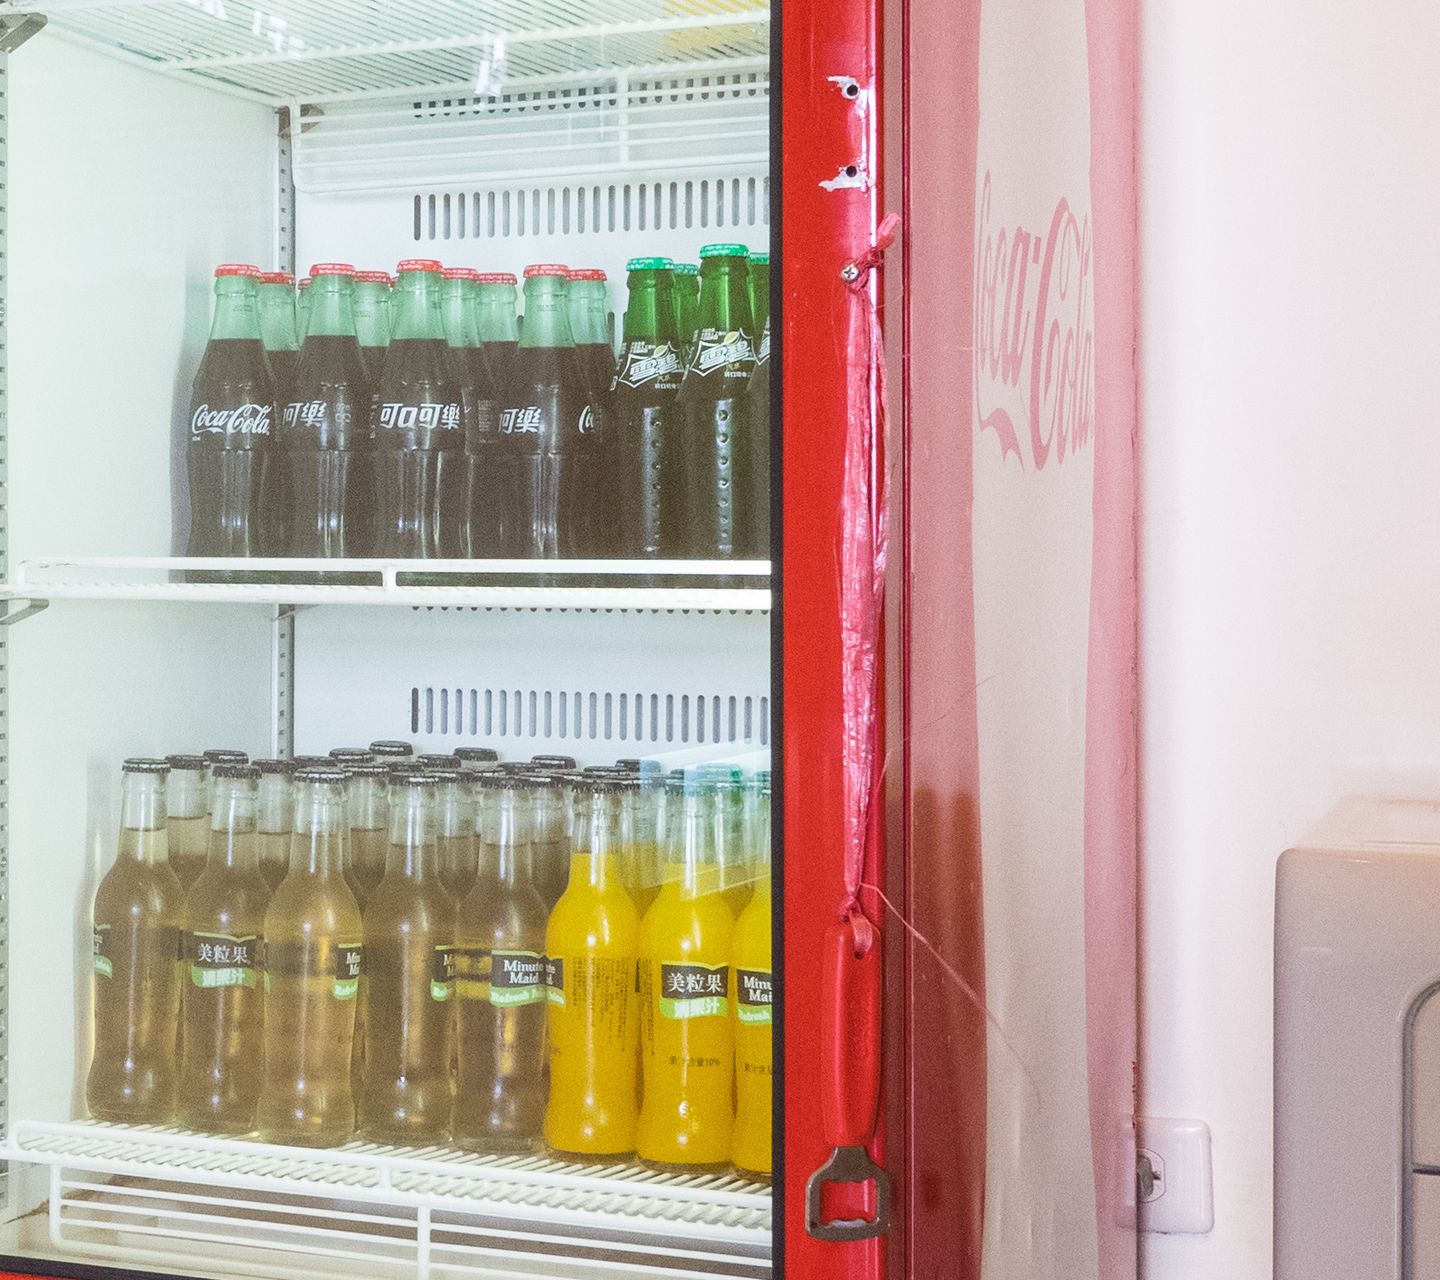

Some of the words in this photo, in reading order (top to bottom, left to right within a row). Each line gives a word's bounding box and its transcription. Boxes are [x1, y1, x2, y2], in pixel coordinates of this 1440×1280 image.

[974, 169, 1092, 471] Coca-Cola
[191, 404, 270, 436] Coca-Cola
[283, 401, 328, 428] 可樂
[380, 403, 460, 430] 可口可樂
[498, 406, 542, 434] 可樂
[197, 943, 248, 964] 美粒果
[503, 959, 544, 973] Minute
[509, 971, 540, 984] Maid
[666, 972, 722, 993] 美粒果
